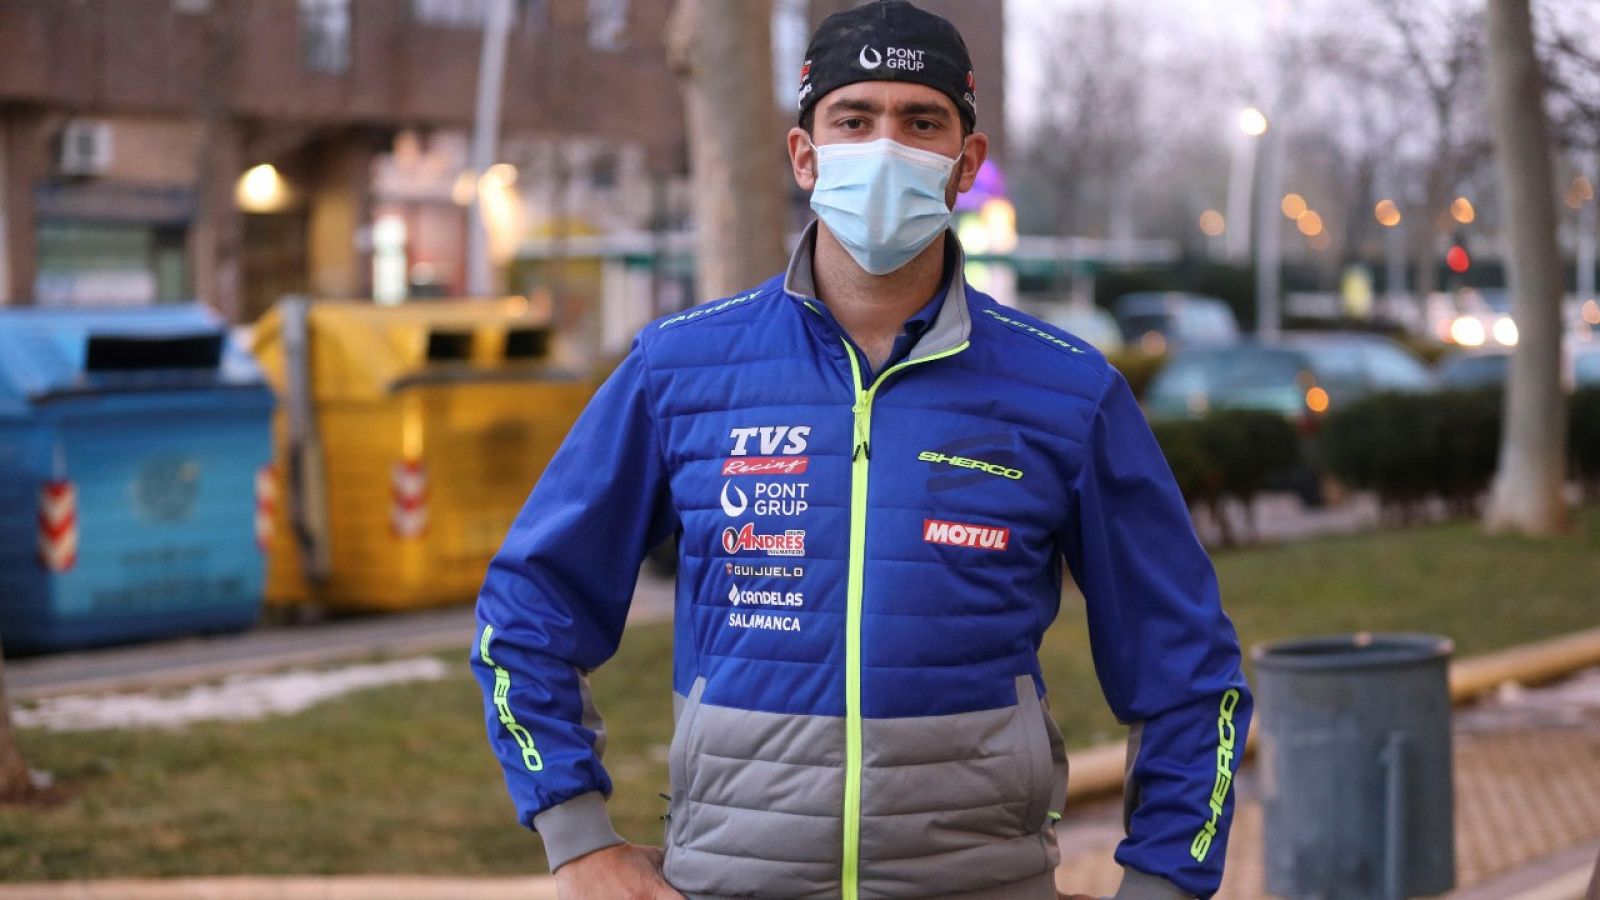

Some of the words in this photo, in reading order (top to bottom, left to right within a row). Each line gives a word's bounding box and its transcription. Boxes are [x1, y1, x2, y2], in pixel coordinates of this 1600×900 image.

[886, 47, 925, 60] PONT
[886, 58, 924, 71] GRUP
[982, 309, 1086, 354] FACTORY
[730, 426, 811, 456] TVS
[723, 459, 806, 475] Racing
[918, 450, 1024, 480] SHERCO
[755, 483, 809, 498] PONT
[755, 500, 808, 516] GRUP
[924, 521, 1007, 550] MOTUL
[734, 565, 804, 577] GUIJUELO
[741, 590, 804, 607] CANDELAS
[728, 613, 801, 632] SALAMANCA
[1190, 688, 1240, 863] SHERCO
